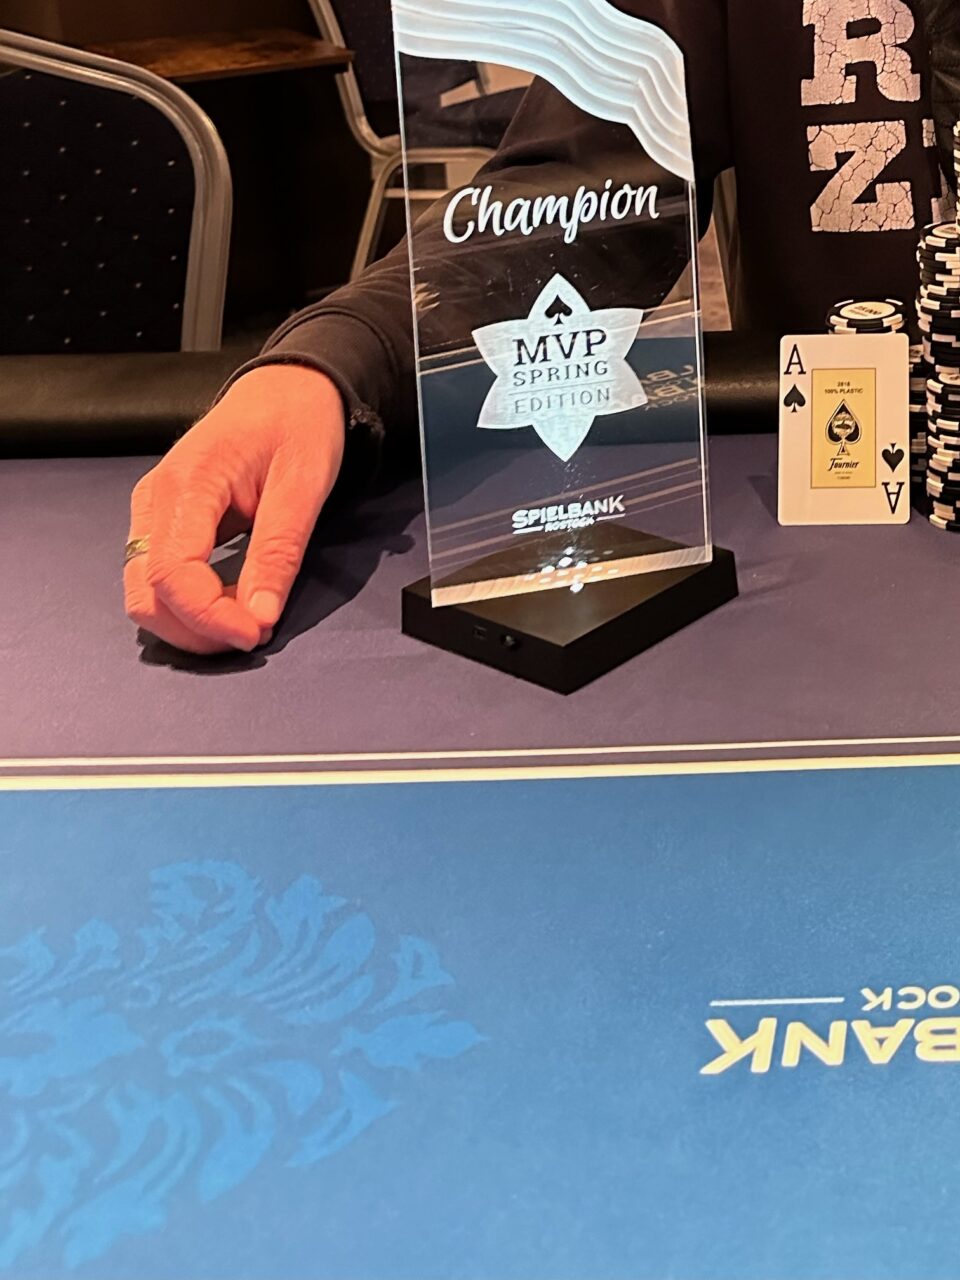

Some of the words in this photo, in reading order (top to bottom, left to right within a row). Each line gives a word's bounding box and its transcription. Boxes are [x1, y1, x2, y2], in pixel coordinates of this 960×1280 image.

[443, 178, 660, 244] Champion
[512, 329, 607, 367] MVP
[783, 343, 807, 375] A
[513, 360, 608, 387] SPRING
[514, 387, 610, 414] EDITION
[511, 494, 626, 529] SPIELBANK
[881, 481, 906, 515] A
[544, 515, 596, 533] ROSTOCK
